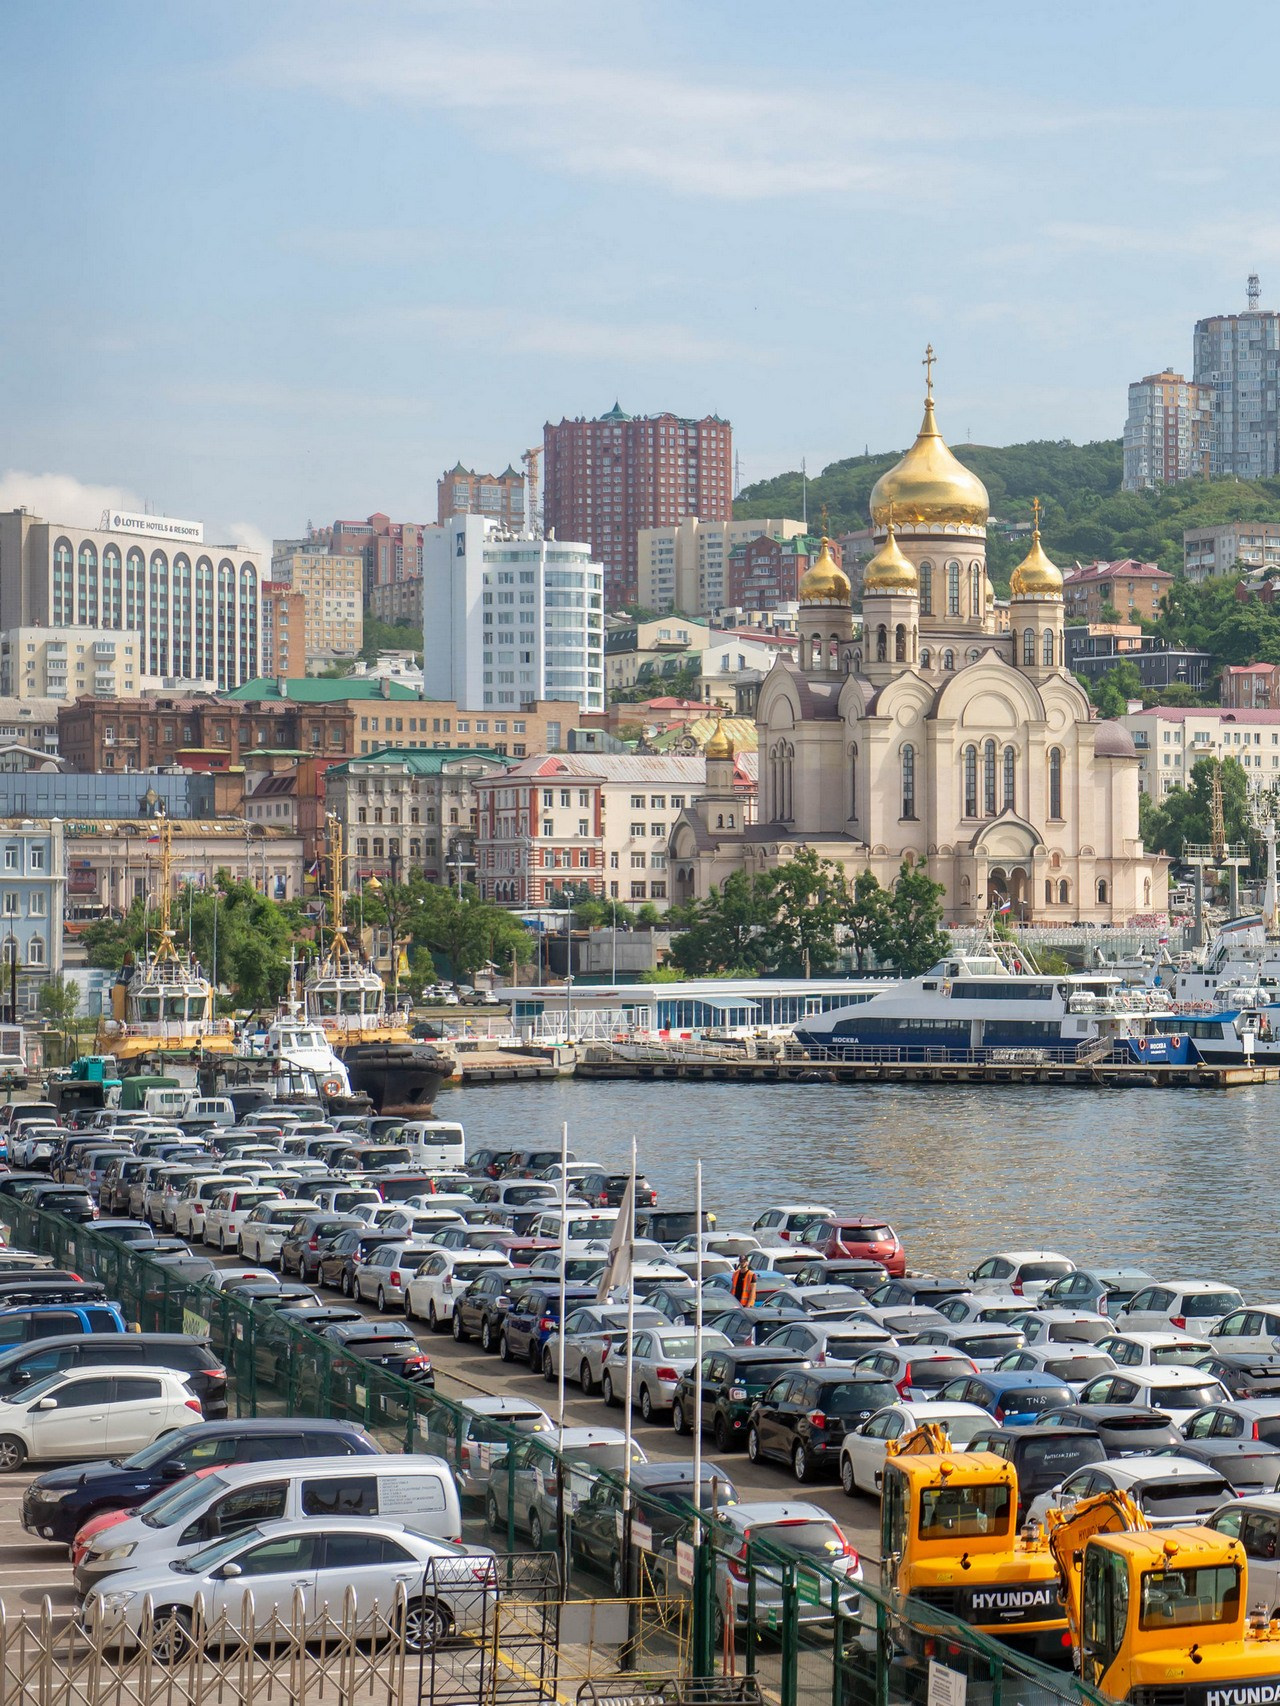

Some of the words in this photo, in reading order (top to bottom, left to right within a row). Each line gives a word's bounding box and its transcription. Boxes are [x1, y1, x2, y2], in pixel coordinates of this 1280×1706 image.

[121, 518, 145, 529] LOTTE
[146, 522, 169, 532] HOTELS
[174, 526, 200, 536] RESORTS
[1026, 1396, 1047, 1405] TNS
[972, 1590, 1050, 1608] HYUNDAI
